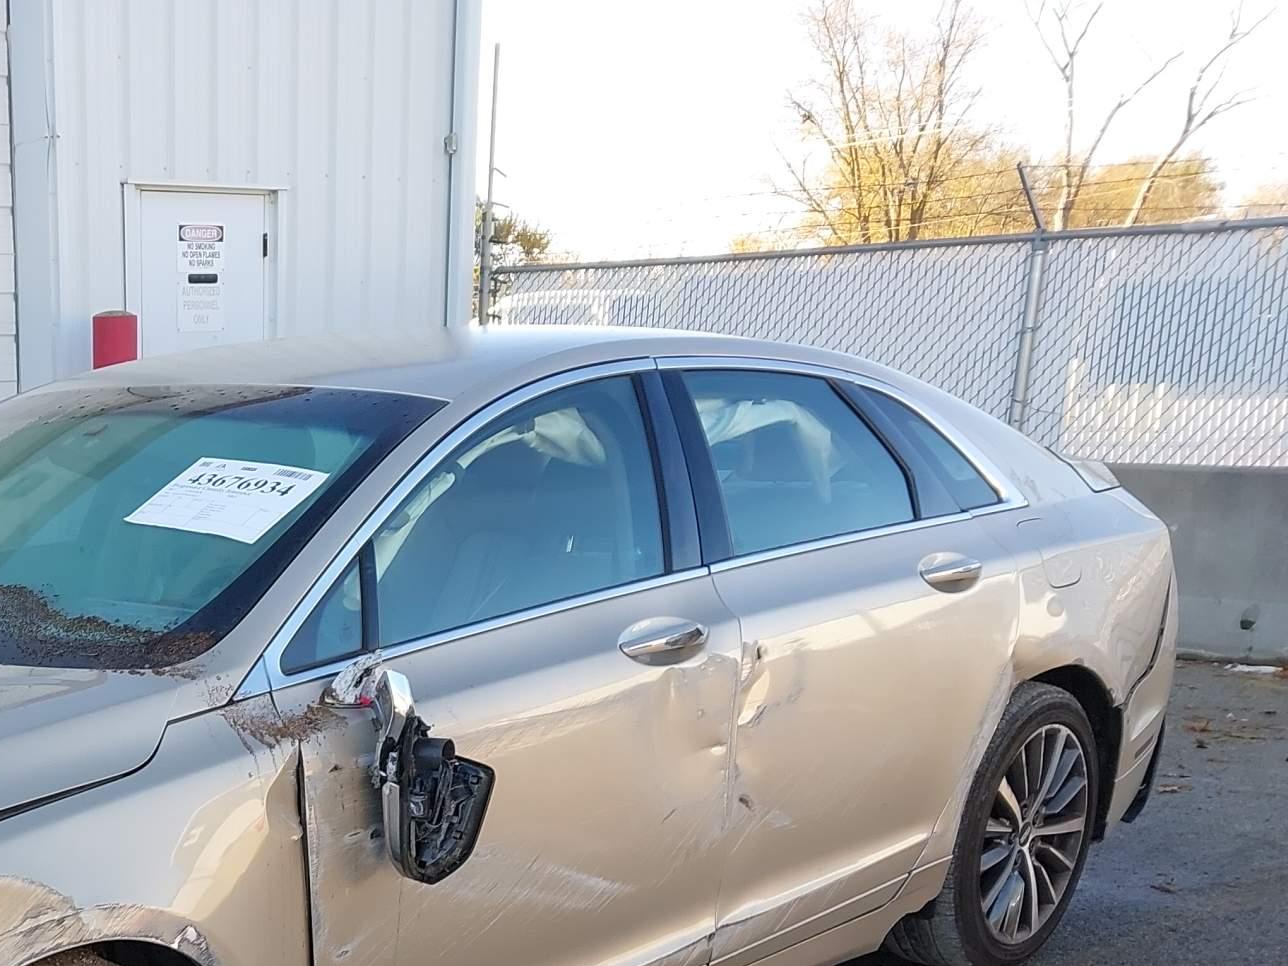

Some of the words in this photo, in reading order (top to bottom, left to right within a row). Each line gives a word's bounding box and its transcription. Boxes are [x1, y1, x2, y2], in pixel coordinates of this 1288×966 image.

[185, 228, 218, 238] DANGER
[203, 251, 221, 259] FLAMES
[196, 259, 214, 267] SPARKS
[182, 286, 220, 297] AUTHORIZED
[183, 300, 220, 310] PERSONNEL
[193, 314, 209, 324] ONLY
[187, 472, 296, 497] 43676934
